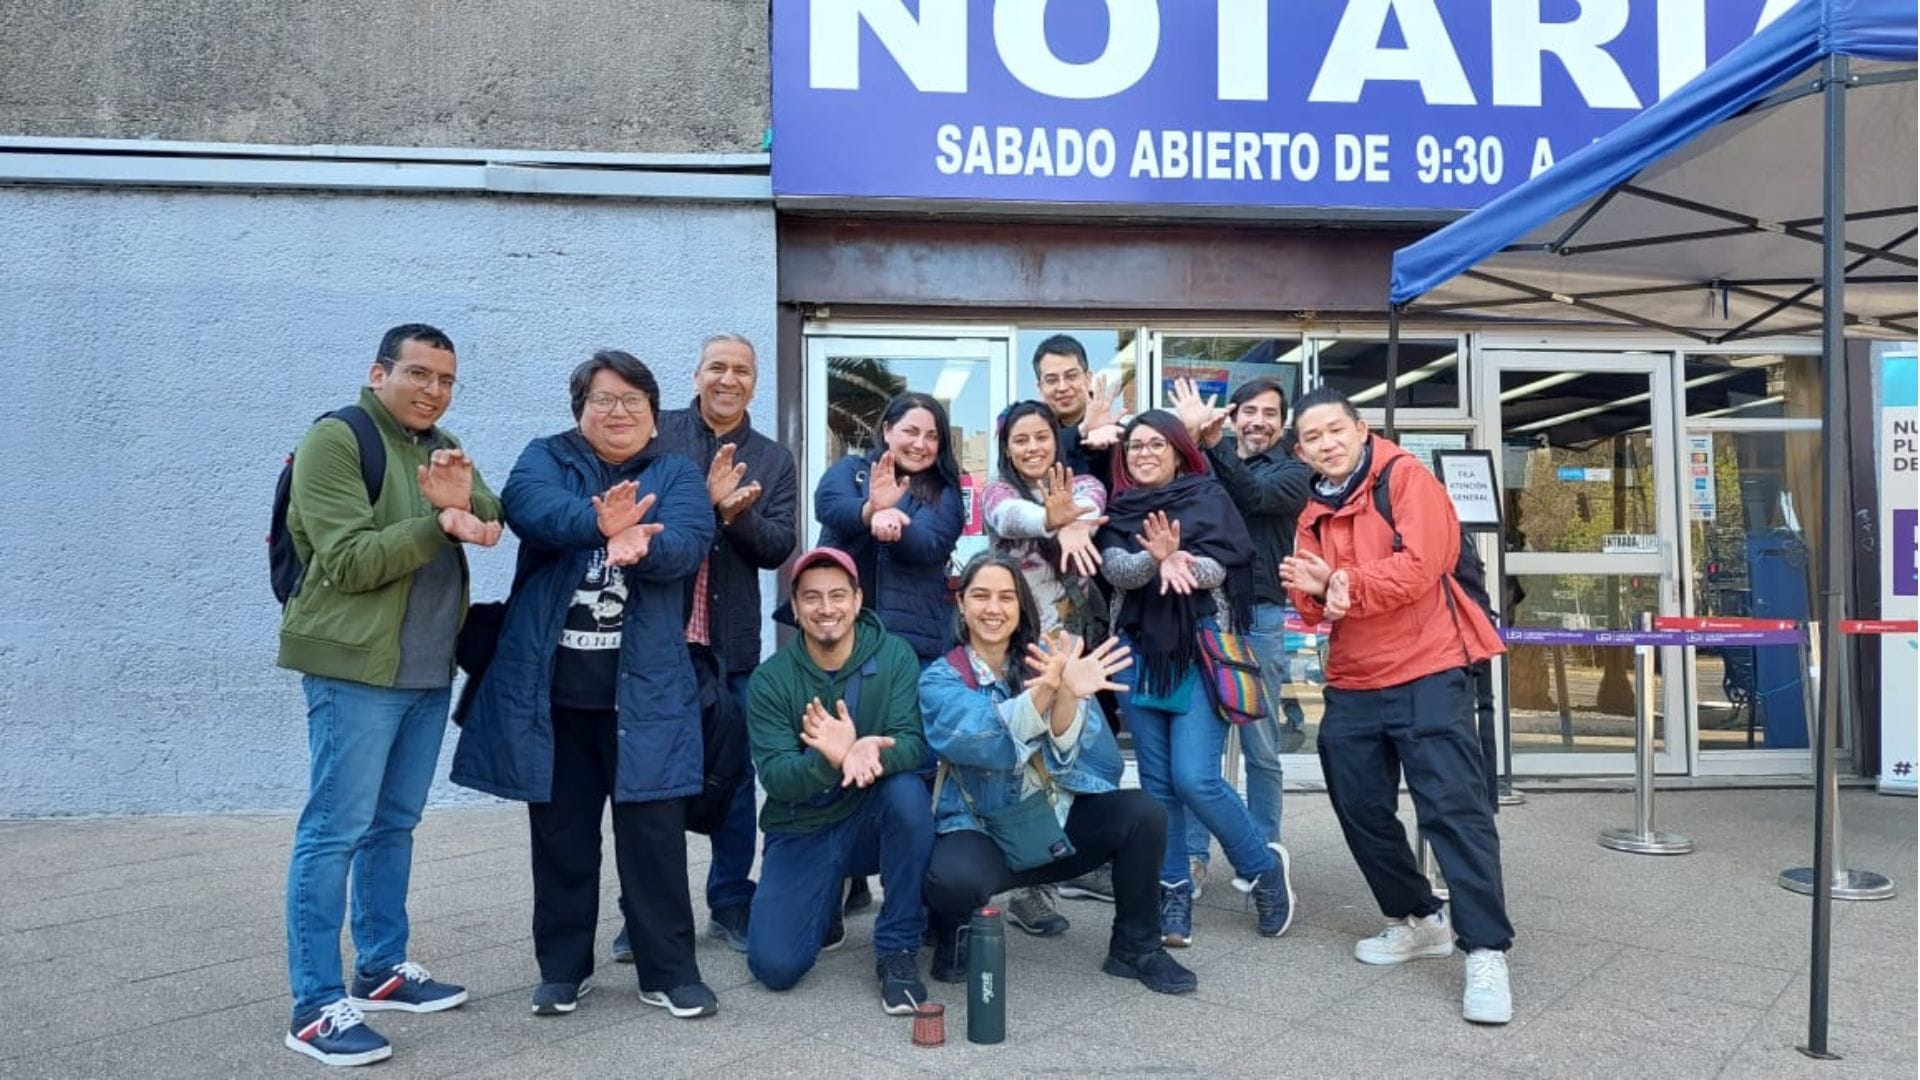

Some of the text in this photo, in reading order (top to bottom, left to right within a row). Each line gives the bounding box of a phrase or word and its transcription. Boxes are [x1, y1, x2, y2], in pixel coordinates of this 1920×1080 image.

[809, 0, 1797, 110] NOTARI
[935, 123, 1556, 184] SABADO ABIERTO DE 9:30 A
